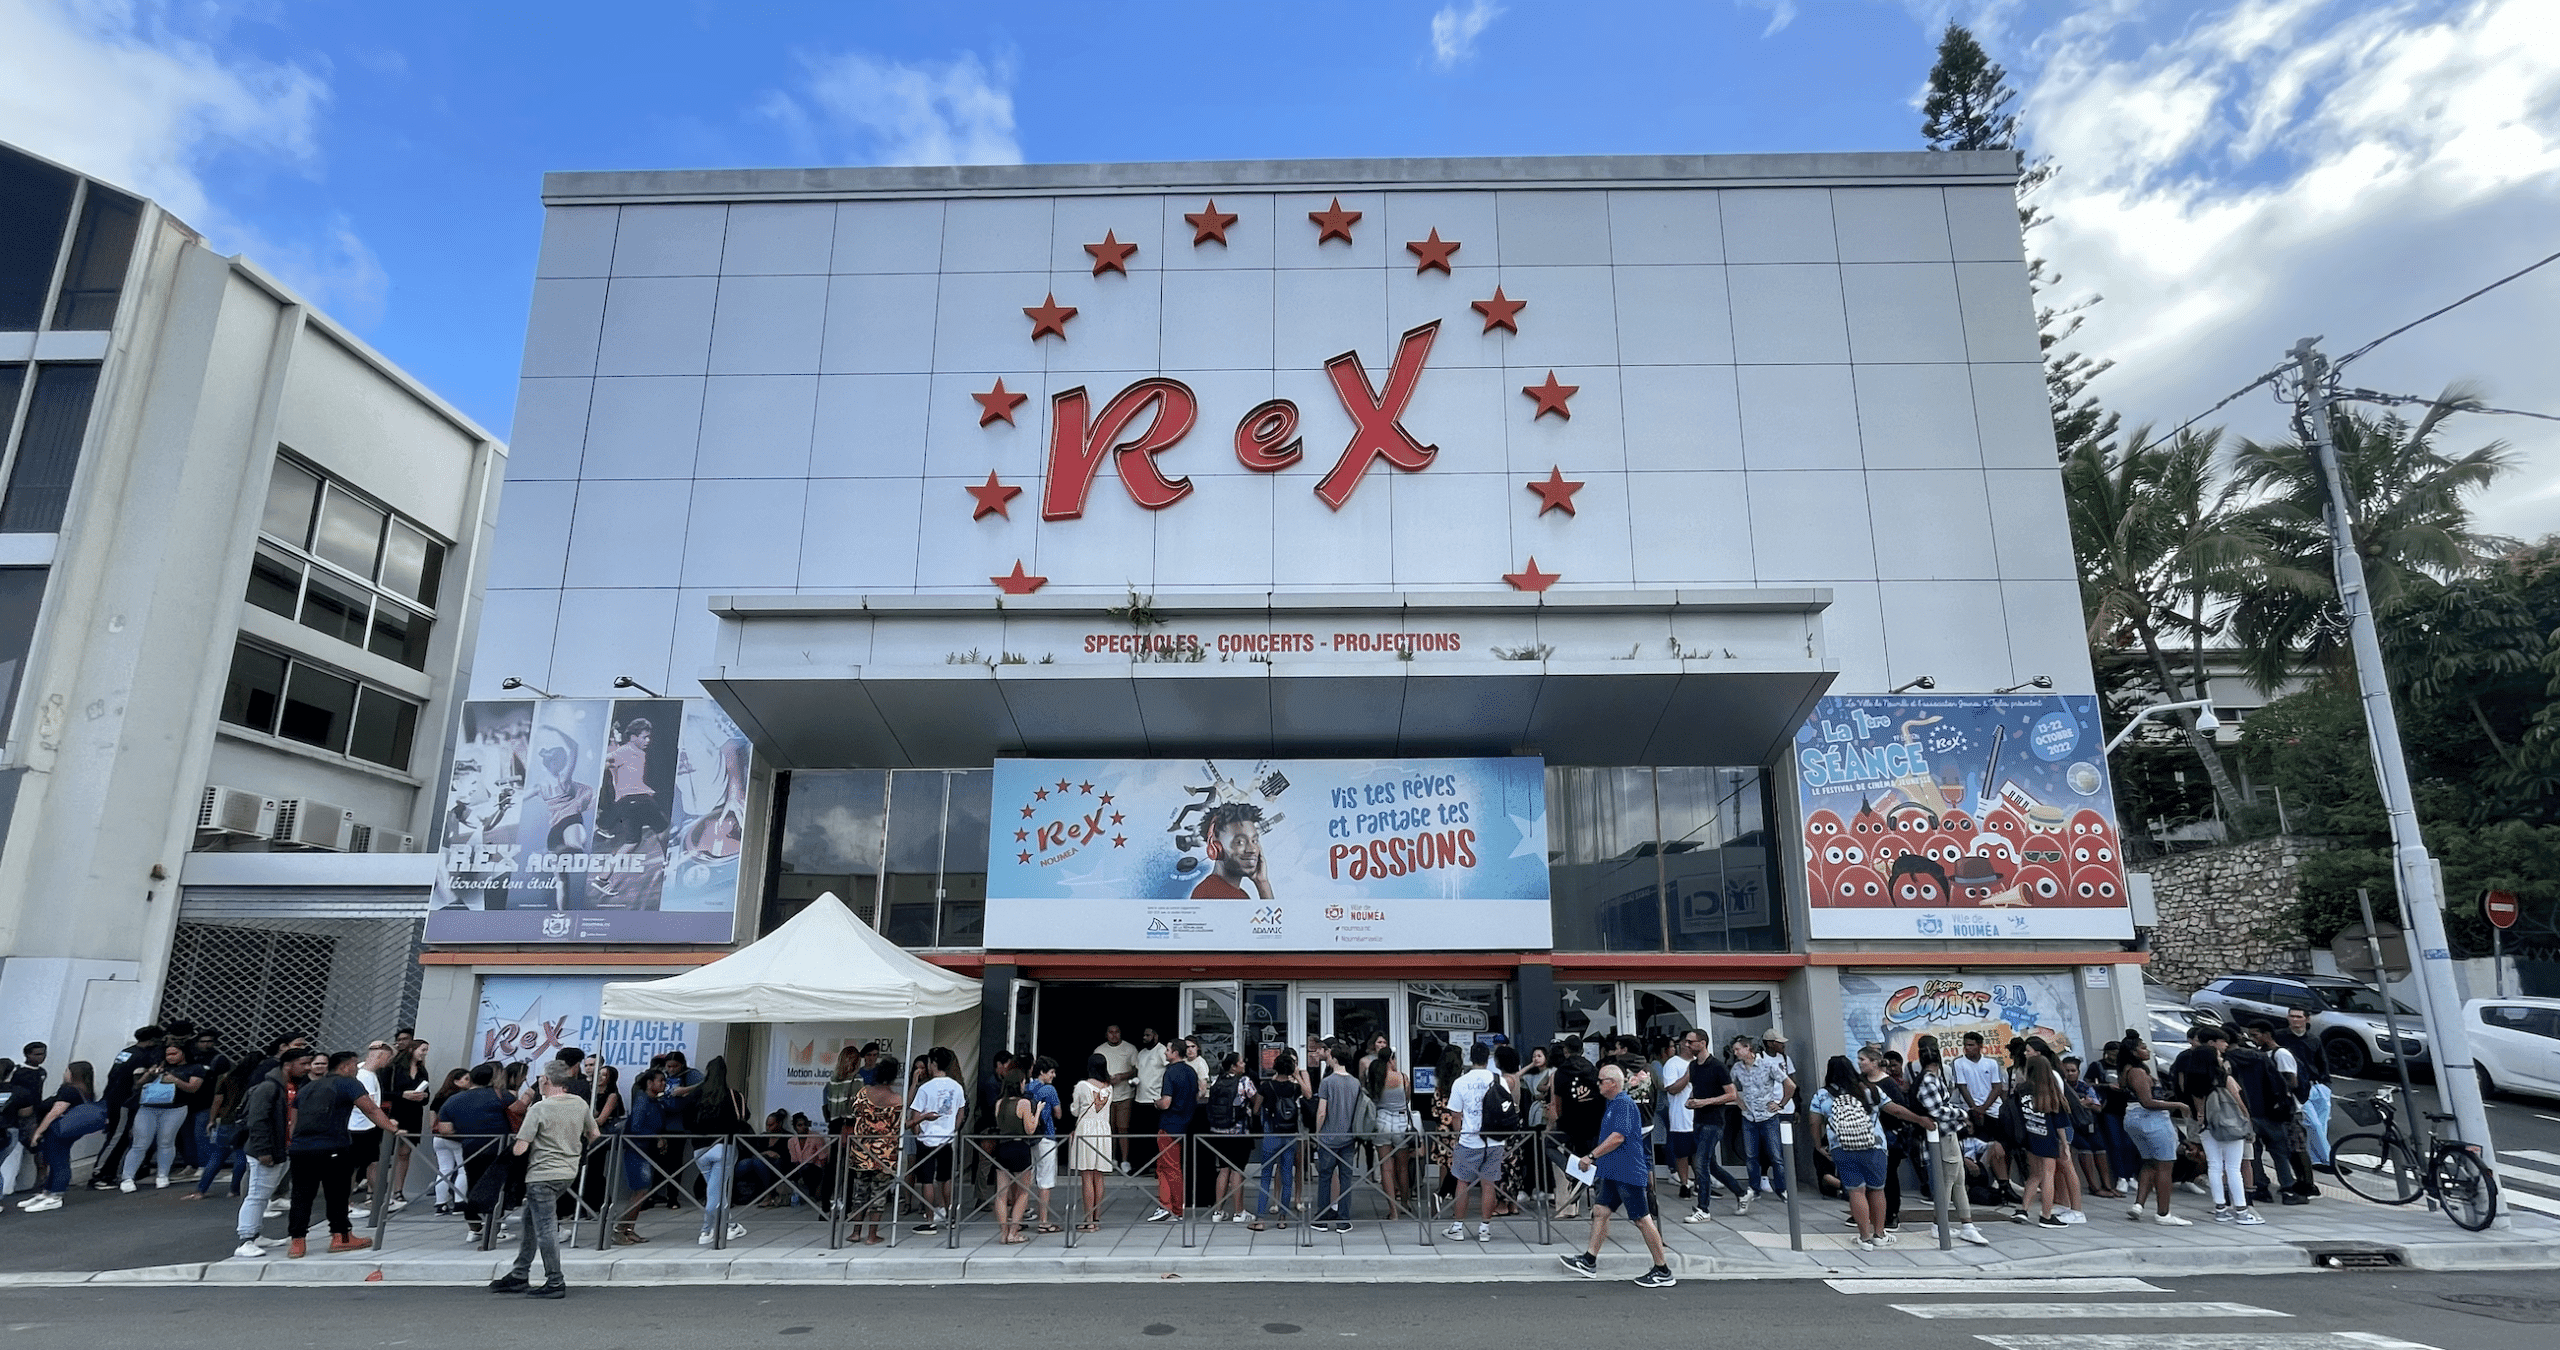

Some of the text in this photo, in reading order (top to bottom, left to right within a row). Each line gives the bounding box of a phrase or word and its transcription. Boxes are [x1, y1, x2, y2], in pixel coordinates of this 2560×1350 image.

[1084, 634, 1198, 653] SPECTACLES
[1217, 633, 1314, 653] CONCERTS
[1333, 633, 1461, 652] PROJECTIONS
[1821, 720, 1852, 743] La
[2038, 719, 2063, 734] 13-22
[2035, 728, 2075, 746] OCTOBRE
[2047, 742, 2072, 756] 2022
[1801, 742, 1930, 787] SÉANCE
[1811, 787, 1820, 796] LE
[1822, 784, 1855, 794] FESTIVAL
[1856, 782, 1866, 791] DE
[449, 843, 647, 873] REX ACADEMIE
[502, 876, 525, 890] ton
[1351, 909, 1386, 921] NOUMÉA
[1951, 914, 1983, 923] Ville de
[1953, 921, 2000, 936] NOUMÉA
[1425, 1010, 1482, 1025] à l'affiche
[1939, 1029, 1999, 1040] SPECLES
[787, 1067, 813, 1078] Motion
